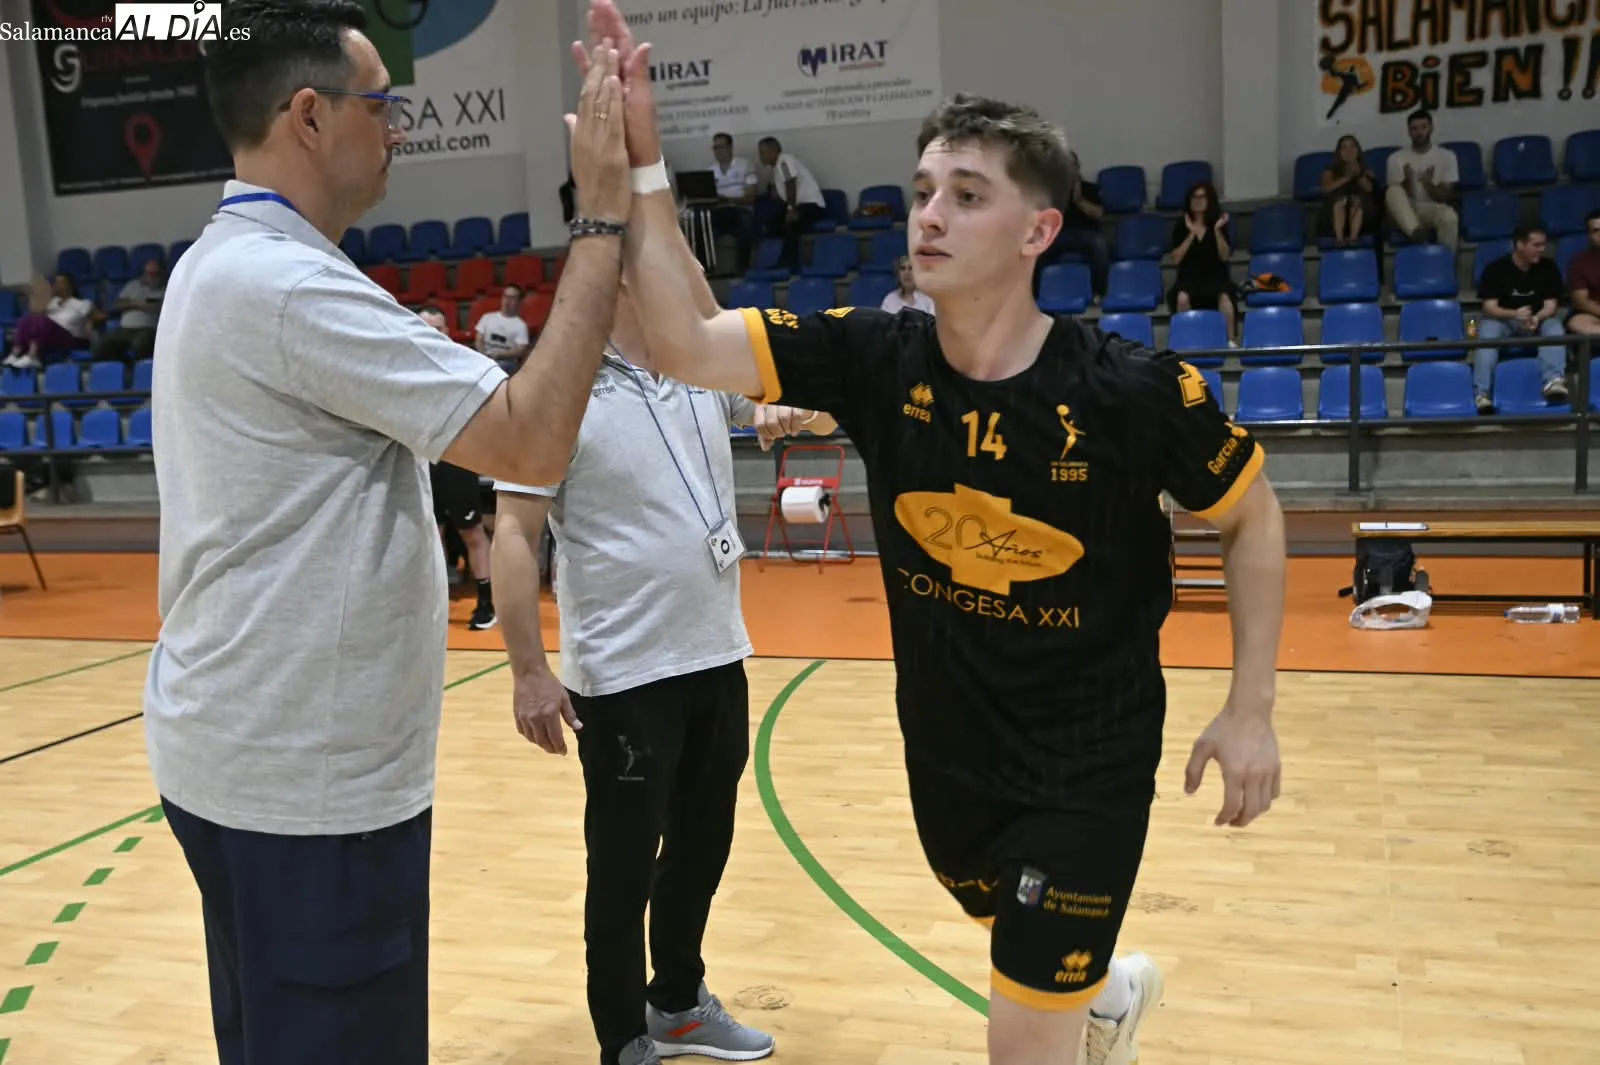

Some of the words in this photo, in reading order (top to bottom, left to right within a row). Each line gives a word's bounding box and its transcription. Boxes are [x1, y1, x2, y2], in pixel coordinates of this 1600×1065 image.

[623, 13, 653, 27] omo
[453, 87, 506, 127] XXI
[960, 409, 1008, 461] 14
[1051, 467, 1089, 482] 1995
[1037, 606, 1080, 629] XXI
